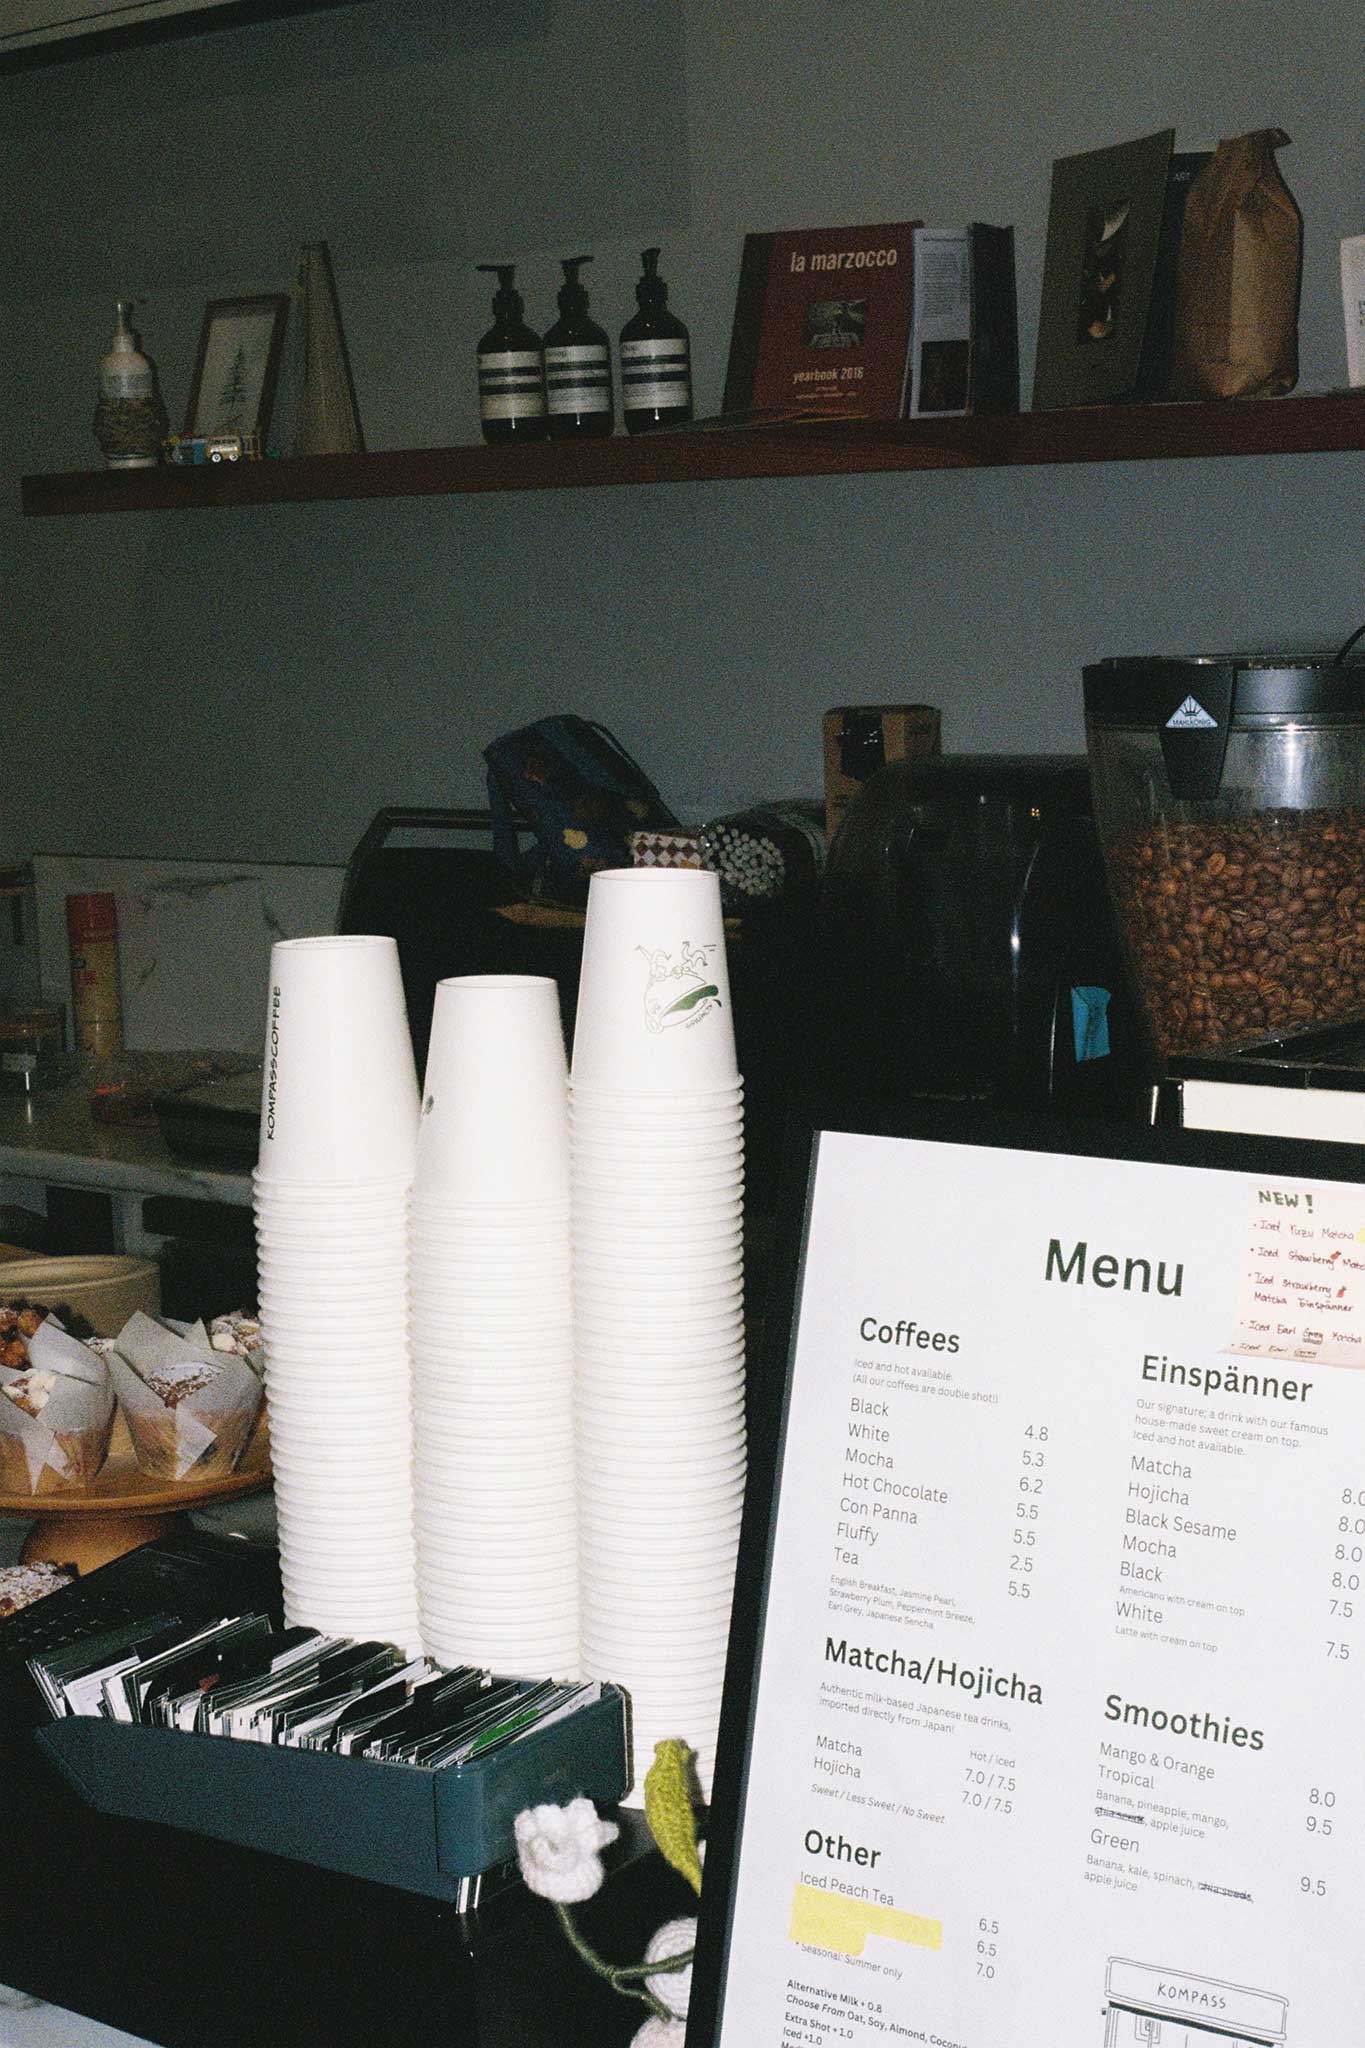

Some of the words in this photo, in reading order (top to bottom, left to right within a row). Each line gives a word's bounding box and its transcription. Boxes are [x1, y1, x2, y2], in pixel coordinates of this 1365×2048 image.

[790, 251, 806, 273] la
[810, 249, 898, 272] marzocco
[792, 368, 838, 385] yearbook
[840, 366, 865, 381] 2016
[1260, 1220, 1280, 1231] Iced
[1290, 1224, 1314, 1238] Yuzu
[1321, 1228, 1354, 1240] Matcha
[1257, 1246, 1279, 1258] Iced
[1045, 1238, 1184, 1297] Menu
[1254, 1272, 1274, 1284] Iced
[1254, 1291, 1287, 1305] Matcha
[860, 1317, 960, 1353] Coffees
[1248, 1320, 1270, 1332] Iced
[854, 1358, 874, 1370] Iced
[875, 1362, 893, 1372] and
[894, 1364, 910, 1376] hot
[1141, 1354, 1313, 1402] Einspänner
[869, 1376, 884, 1386] our
[886, 1378, 920, 1392] coffees
[922, 1386, 937, 1396] are
[938, 1386, 970, 1400] double
[850, 1398, 890, 1417] Black
[1136, 1398, 1156, 1410] Our
[1218, 1411, 1244, 1424] drink
[1246, 1415, 1268, 1428] with
[1270, 1420, 1288, 1430] our
[1290, 1420, 1329, 1437] famous
[848, 1422, 890, 1443] White
[1024, 1424, 1050, 1442] 4.8
[1133, 1431, 1156, 1443] Iced
[1157, 1434, 1178, 1446] and
[1179, 1437, 1196, 1449] hot
[1134, 1414, 1198, 1434] house-made
[1199, 1426, 1230, 1438] sweet
[1231, 1430, 1264, 1443] cream
[1266, 1435, 1279, 1444] on
[845, 1448, 894, 1469] Mocha
[1022, 1450, 1045, 1468] 5.3
[1130, 1455, 1192, 1479] Matcha
[842, 1472, 868, 1491] Hot
[872, 1477, 949, 1504] Chocolate
[1019, 1476, 1044, 1494] 6.2
[1128, 1481, 1190, 1507] Hojicha
[840, 1497, 868, 1516] Con
[872, 1503, 918, 1525] Panna
[1016, 1502, 1039, 1520] 5.5
[836, 1522, 879, 1547] Fluffy
[1125, 1508, 1169, 1530] Black
[1173, 1516, 1237, 1541] Sesame
[1338, 1516, 1365, 1535] 8.0
[1013, 1528, 1036, 1546] 5.5
[1122, 1534, 1178, 1559] Mocha
[834, 1546, 859, 1565] Tea
[1010, 1554, 1034, 1573] 2.5
[1334, 1544, 1363, 1563] 8.0
[1120, 1560, 1163, 1584] Black
[1332, 1572, 1360, 1592] 8.0
[830, 1574, 858, 1588] English
[900, 1588, 932, 1602] Jasmine
[1008, 1580, 1031, 1600] 5.5
[829, 1588, 872, 1606] Strawberry
[897, 1601, 944, 1618] Peppermint
[1116, 1600, 1164, 1624] White
[1119, 1584, 1166, 1602] Americano
[1166, 1595, 1186, 1606] with
[1187, 1599, 1215, 1612] cream
[1216, 1604, 1228, 1614] on
[1230, 1605, 1246, 1618] top
[1328, 1599, 1353, 1618] 7.5
[828, 1600, 843, 1611] Earl
[866, 1608, 904, 1624] Japanese
[904, 1616, 934, 1630] Sencha
[1115, 1625, 1138, 1638] Latte
[1140, 1630, 1159, 1642] with
[1160, 1634, 1188, 1648] cream
[1188, 1640, 1201, 1649] on
[1202, 1641, 1218, 1654] top
[1325, 1641, 1350, 1660] 7.5
[824, 1636, 1044, 1705] Matcha/Hojicha
[820, 1681, 864, 1700] Authentic
[865, 1690, 914, 1711] milk-based
[916, 1703, 962, 1722] Japanese
[963, 1712, 979, 1724] tea
[861, 1705, 896, 1725] directly
[898, 1712, 921, 1727] from
[1104, 1694, 1265, 1751] Smoothies
[816, 1735, 863, 1757] Matcha
[970, 1750, 987, 1763] Hot
[813, 1756, 862, 1779] Hojicha
[1100, 1742, 1146, 1766] Mango
[1150, 1753, 1160, 1768] &
[1163, 1755, 1216, 1781] Orange
[964, 1768, 985, 1785] 7.0
[998, 1776, 1016, 1792] 7.5
[1098, 1764, 1155, 1790] Tropical
[810, 1783, 840, 1799] Sweet
[846, 1791, 866, 1806] Less
[867, 1796, 896, 1813] Sweet
[903, 1804, 916, 1817] No
[916, 1808, 946, 1824] Sweet
[962, 1790, 982, 1808] 7.0
[994, 1798, 1012, 1814] 7.5
[1095, 1789, 1134, 1807] Banana,
[1137, 1799, 1190, 1820] pineapple,
[1308, 1788, 1336, 1808] 8.0
[1150, 1817, 1178, 1833] apple
[1180, 1825, 1206, 1839] juice
[1305, 1815, 1333, 1836] 9.5
[804, 1829, 882, 1869] Other
[1090, 1828, 1140, 1853] Green
[1084, 1870, 1112, 1886] apple
[1113, 1877, 1138, 1892] juice
[1086, 1854, 1126, 1873] Banana,
[1153, 1870, 1196, 1891] spinach,
[800, 1871, 828, 1888] Iced
[830, 1878, 870, 1899] Peach
[872, 1888, 894, 1906] Tea
[1300, 1876, 1327, 1897] 9.5
[979, 1918, 1000, 1934] 6.5
[976, 1940, 997, 1958] 6.5
[844, 1954, 882, 1972] Summer
[882, 1966, 904, 1981] only
[976, 1962, 995, 1980] 7.0
[786, 1979, 838, 2002] Alternative
[840, 1992, 860, 2008] Milk
[867, 2001, 882, 2014] 0.8
[1157, 1982, 1227, 2010] KOMPASS
[784, 2012, 808, 2026] Extra
[810, 2018, 831, 2032] Shot
[839, 2027, 854, 2040] 1.0
[786, 1994, 820, 2012] Choose
[822, 2003, 846, 2018] From
[890, 2023, 928, 2042] Almond,
[783, 2026, 802, 2039] Iced
